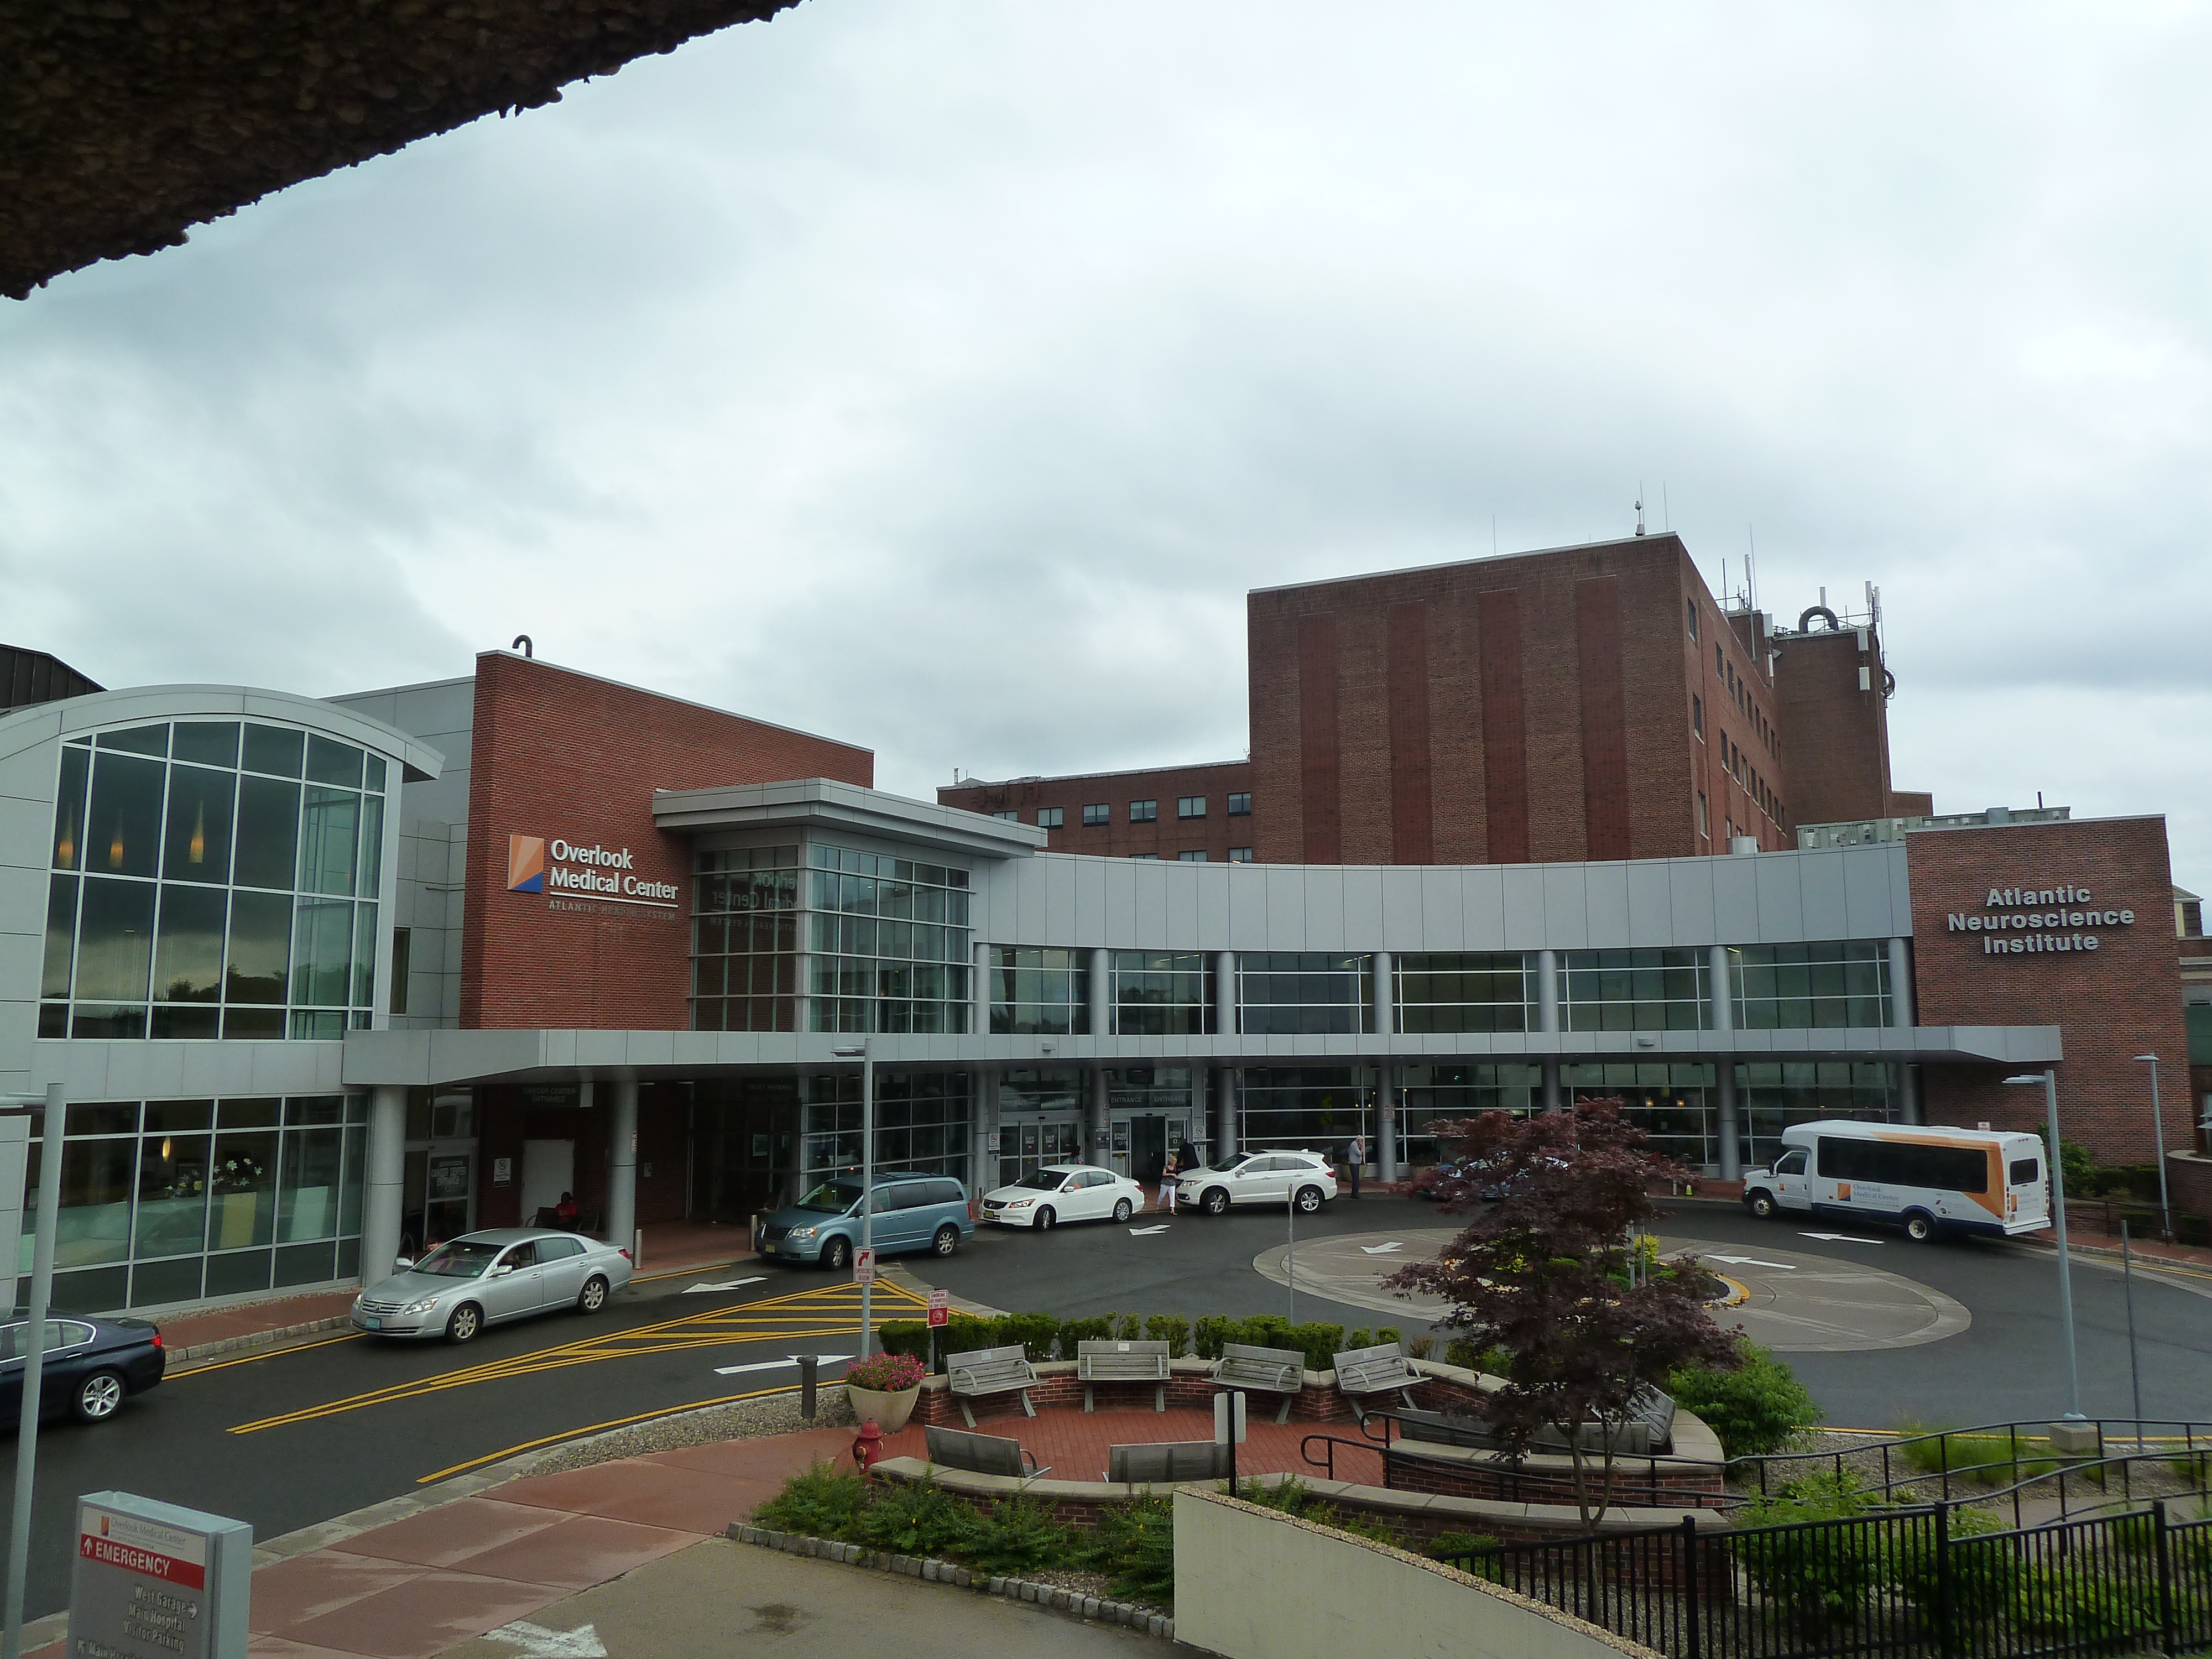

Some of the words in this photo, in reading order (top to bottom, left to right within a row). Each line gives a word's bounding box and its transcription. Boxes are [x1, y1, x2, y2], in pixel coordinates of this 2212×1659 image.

[551, 839, 633, 869] Overlook
[550, 867, 619, 893] Medical
[624, 876, 679, 899] Center
[1986, 885, 2091, 906] Atlantic
[549, 901, 597, 912] ATLANTIC
[641, 910, 675, 920] SYSTEM
[1948, 908, 2135, 931] Neuroscience
[1984, 933, 2099, 953] Institute
[112, 1517, 138, 1532] Overlook
[140, 1525, 164, 1539] Medical
[164, 1531, 186, 1545] Center
[95, 1541, 171, 1576] EMERGENCY
[135, 1585, 155, 1603] West
[157, 1592, 186, 1614] Garage
[129, 1603, 149, 1621] Main
[150, 1609, 185, 1631] Hospital
[89, 1641, 108, 1659] Main
[123, 1620, 150, 1641] Visitor
[152, 1629, 184, 1655] Parking
